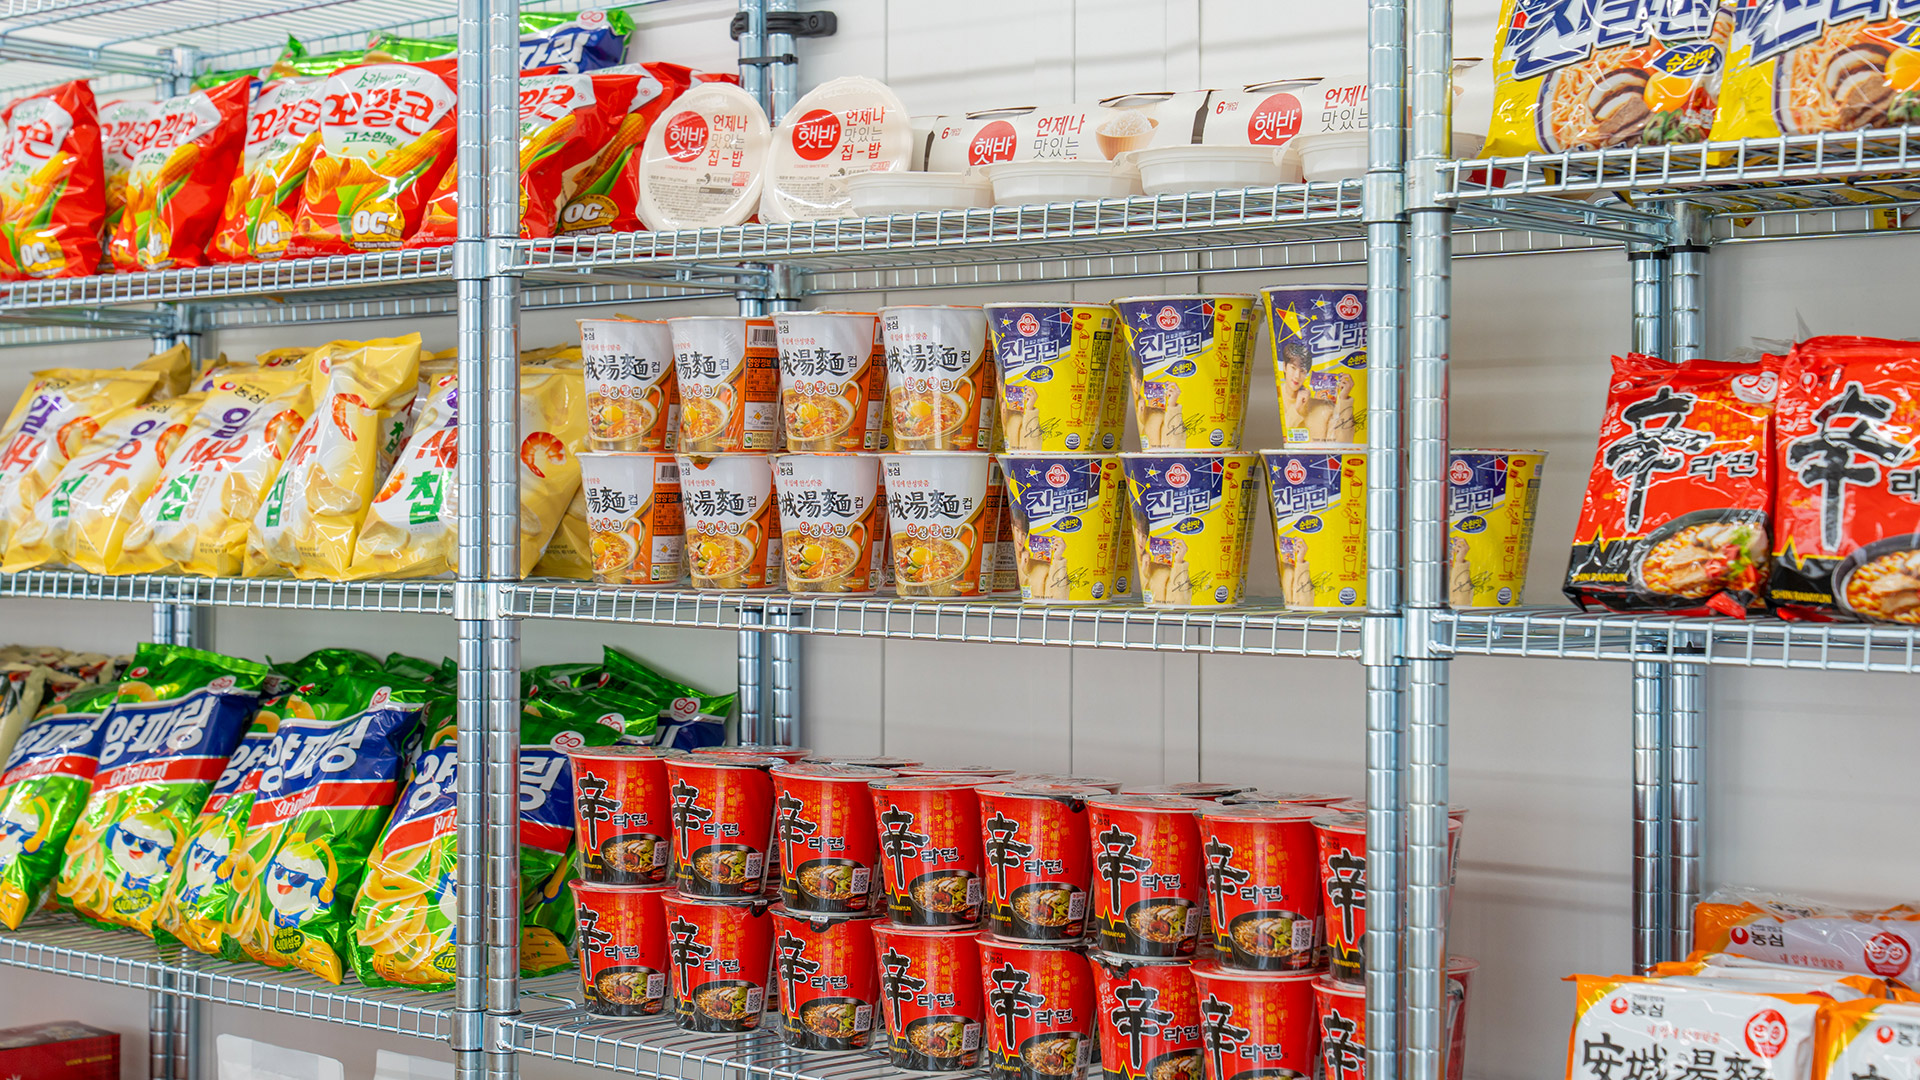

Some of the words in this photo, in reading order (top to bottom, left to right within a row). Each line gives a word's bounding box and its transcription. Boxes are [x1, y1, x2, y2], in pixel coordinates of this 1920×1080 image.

[1665, 47, 1716, 72] 순한맛
[325, 89, 434, 137] 꼬깔콘
[519, 85, 576, 122] 깔콘
[713, 115, 748, 132] 언제나
[846, 107, 885, 126] 언제나
[1036, 114, 1085, 137] 언제나
[1254, 110, 1297, 142] 햇반
[670, 126, 706, 150] 햇반
[798, 125, 838, 149] 햇반
[844, 127, 883, 144] 맛있는
[1033, 137, 1079, 159] 맛있는
[974, 136, 1015, 165] 햇반
[353, 211, 389, 235] OC
[564, 203, 603, 223] OC
[847, 355, 857, 367] 컵
[961, 350, 970, 363] 컵
[1002, 338, 1059, 368] 진라면
[1139, 332, 1202, 365] 진라면
[651, 361, 661, 372] 컵
[719, 358, 729, 370] 컵
[1030, 368, 1050, 379] 순한맛
[1172, 363, 1193, 375] 순한맛
[180, 434, 249, 472] 새우
[1604, 386, 1715, 534] 辛
[1689, 450, 1759, 483] 라면
[780, 467, 793, 475] 농심
[1786, 381, 1915, 552] 辛
[1887, 468, 1920, 503] 라
[406, 470, 453, 525] 칩
[629, 494, 638, 505] 컵
[747, 496, 756, 507] 컵
[854, 497, 864, 508] 컵
[963, 498, 973, 510] 컵
[1026, 489, 1088, 519] 진라면
[1146, 489, 1210, 520] 진라면
[1273, 486, 1328, 518] 진라면
[1450, 487, 1494, 515] 라면
[800, 521, 846, 537] 안성탕면
[907, 522, 953, 538] 안성탕면
[1059, 518, 1079, 530] 순한맛
[1180, 520, 1201, 532] 순한맛
[1300, 518, 1318, 529] 순한맛
[1461, 519, 1482, 530] 순한맛
[99, 695, 215, 765] 양파링
[259, 716, 375, 793] 양파링
[578, 771, 621, 850] 辛
[613, 813, 648, 827] 라면
[672, 779, 712, 861] 辛
[703, 822, 740, 838] 라면
[779, 790, 817, 874] 辛
[807, 835, 845, 852] 라면
[881, 804, 930, 891] 辛
[920, 847, 959, 865] 라면
[986, 811, 1034, 901] 辛
[1023, 859, 1062, 876] 라면
[1099, 823, 1152, 915] 辛
[1141, 873, 1182, 891] 라면
[1204, 835, 1250, 930] 辛
[1240, 885, 1283, 905] 라면
[1750, 931, 1784, 947] 농심
[604, 945, 640, 960] 라면
[671, 915, 712, 997] 辛
[703, 959, 740, 975] 라면
[778, 930, 820, 1013] 辛
[810, 974, 848, 992] 라면
[882, 947, 926, 1033] 辛
[916, 992, 954, 1009] 라면
[989, 963, 1046, 1050] 辛
[1034, 1008, 1073, 1026] 라면
[1631, 1002, 1664, 1018] 농심
[1112, 979, 1174, 1070] 辛
[1200, 994, 1250, 1080] 辛
[1240, 1043, 1283, 1062] 라면
